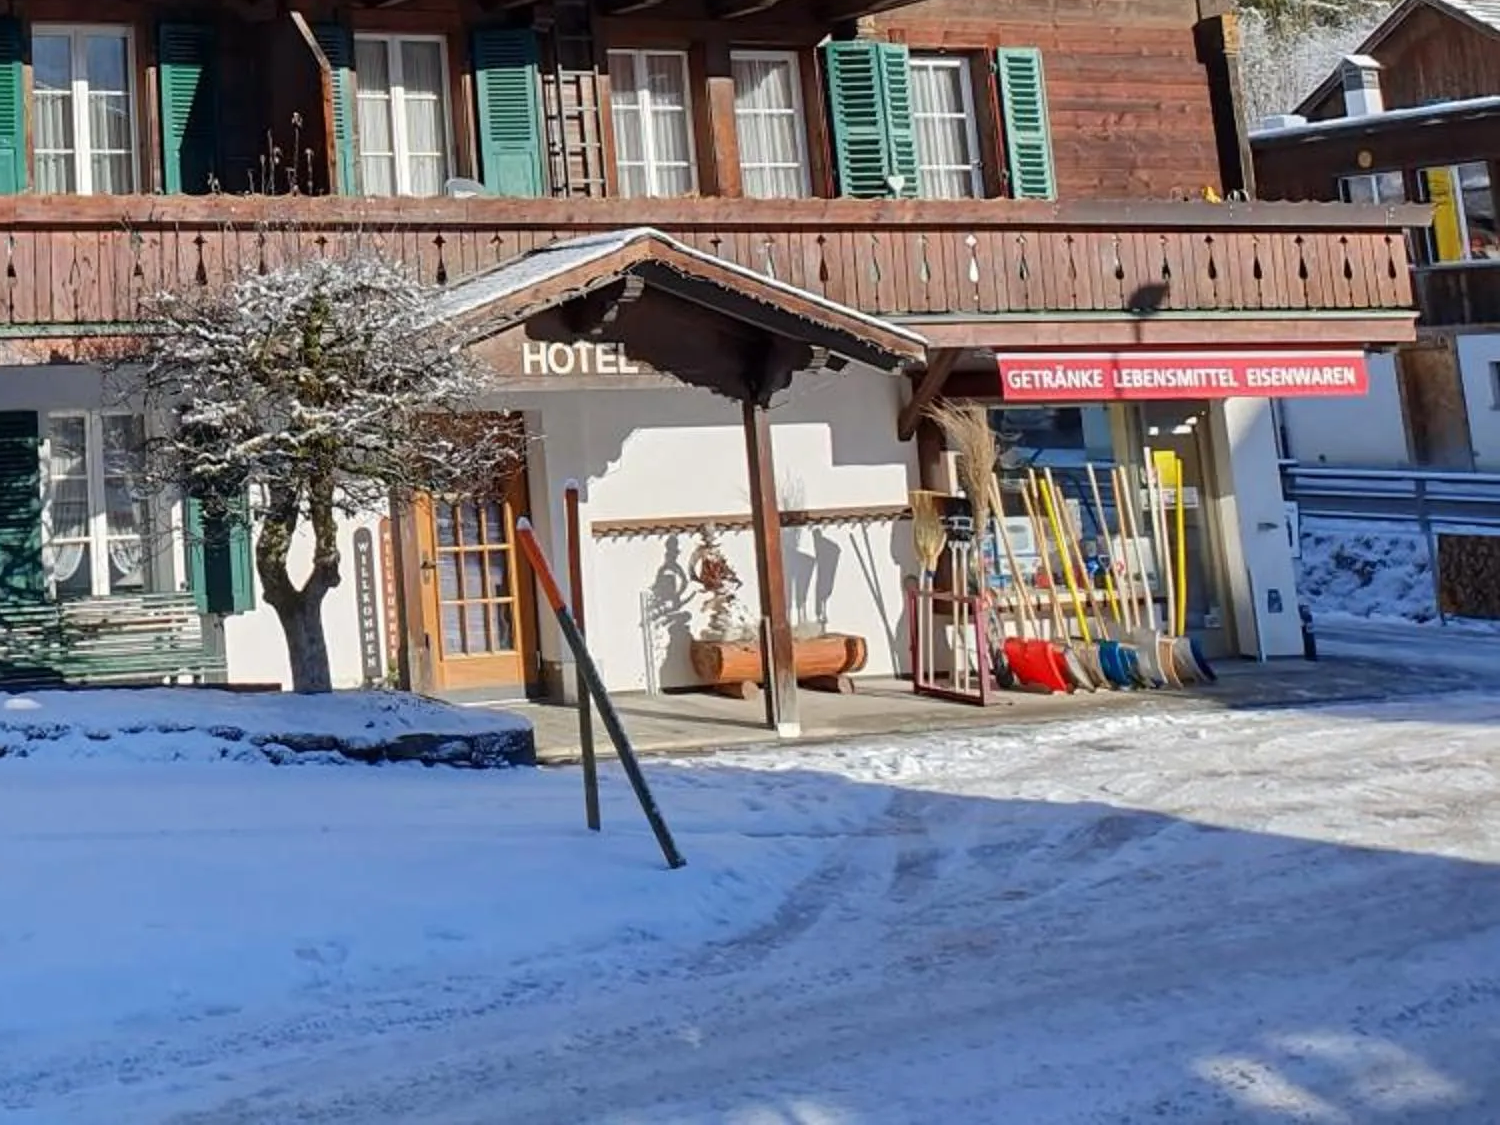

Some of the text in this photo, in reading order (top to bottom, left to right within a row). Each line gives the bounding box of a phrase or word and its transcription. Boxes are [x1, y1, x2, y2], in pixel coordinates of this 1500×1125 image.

[522, 340, 640, 374] HOTEL
[1007, 364, 1357, 389] GETRÄNKE LEBENSMITTEL EISENWAREN
[356, 541, 378, 669] WILLKOMMEN
